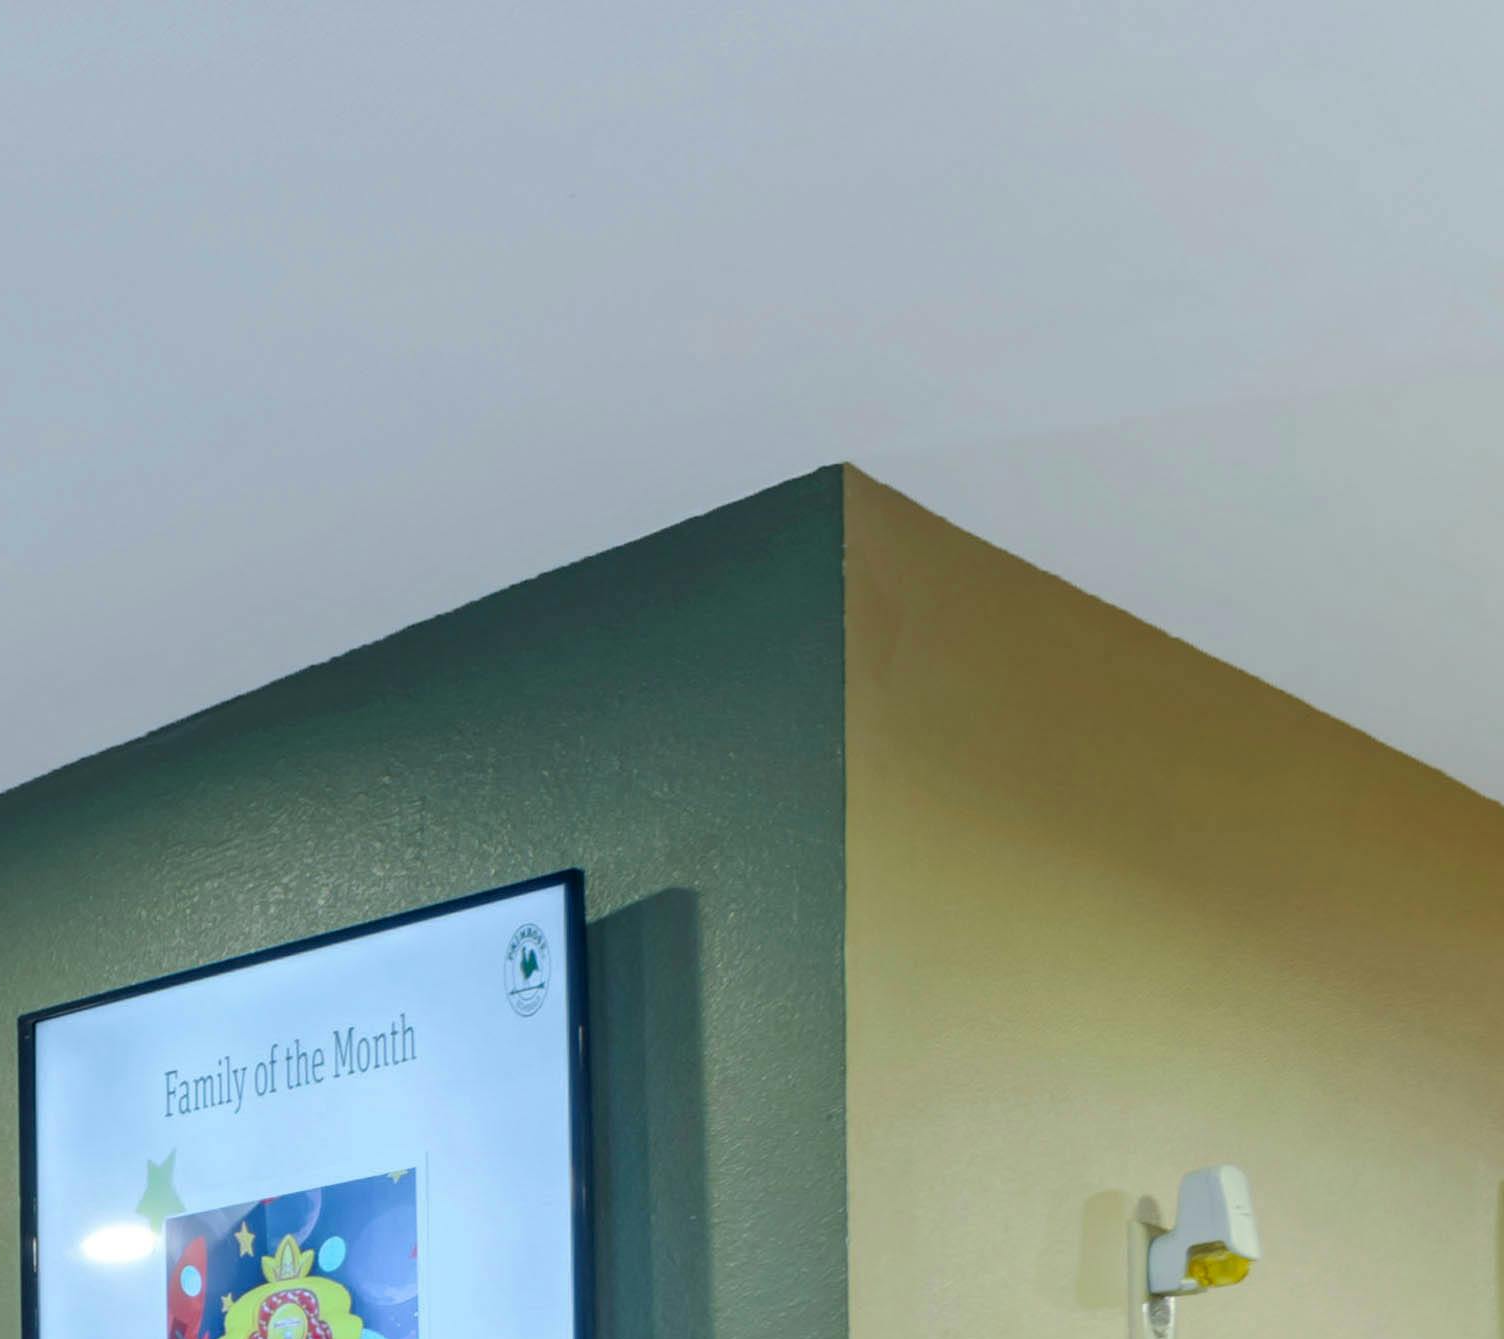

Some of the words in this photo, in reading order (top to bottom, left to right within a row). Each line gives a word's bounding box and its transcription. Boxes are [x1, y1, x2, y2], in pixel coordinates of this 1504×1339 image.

[164, 1056, 247, 1117] Family
[254, 1043, 279, 1096] of
[285, 1038, 325, 1090] the
[333, 1012, 417, 1078] Month
